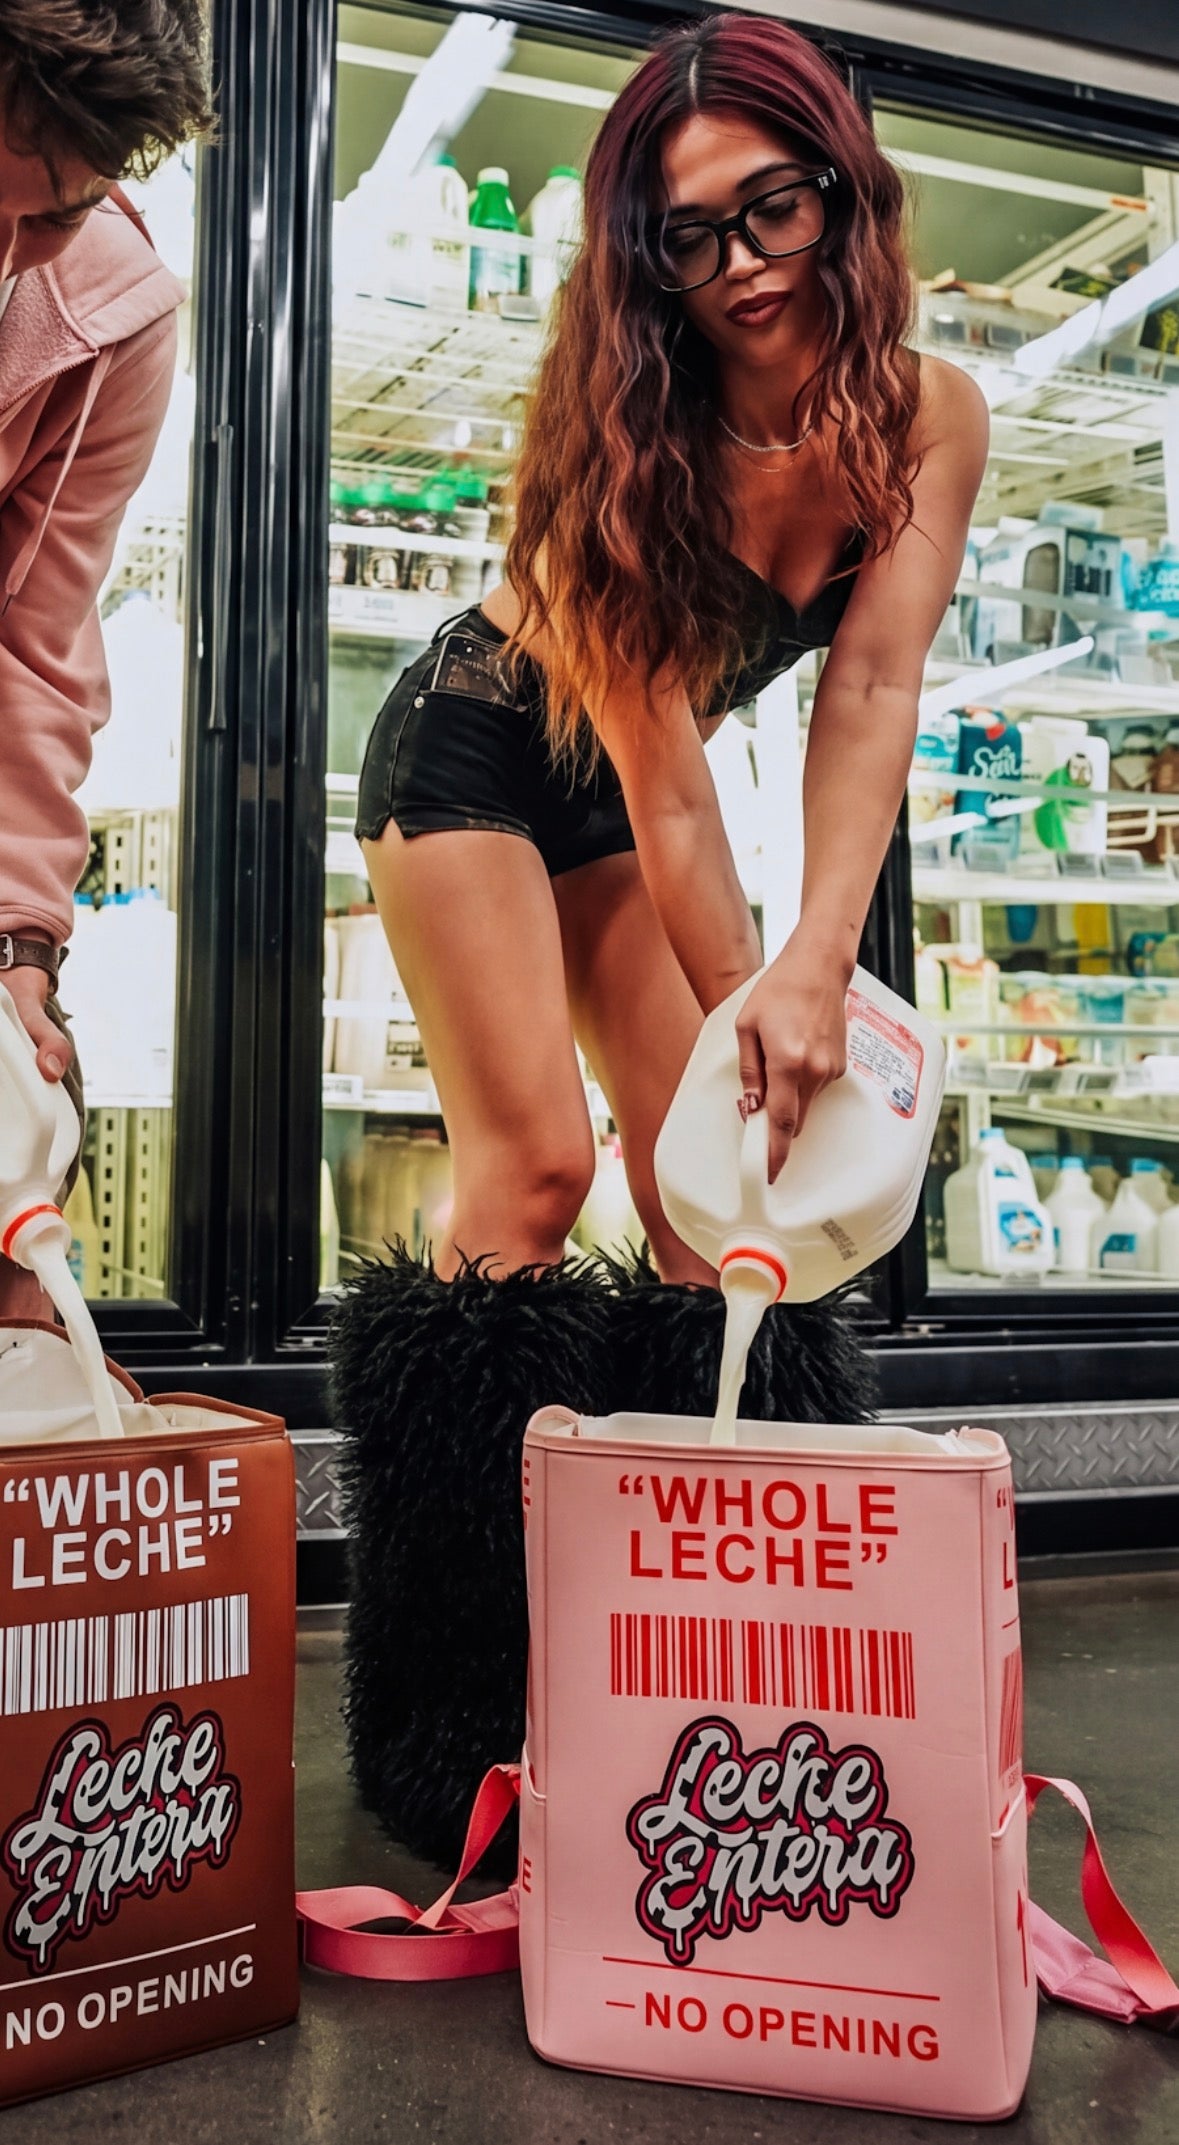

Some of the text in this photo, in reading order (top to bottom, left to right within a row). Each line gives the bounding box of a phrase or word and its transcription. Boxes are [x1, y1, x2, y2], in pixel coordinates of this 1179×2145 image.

[4, 1458, 241, 1529] “WHOLE
[618, 1474, 899, 1536] “WHOLE
[12, 1513, 232, 1590] LECHE”
[630, 1529, 888, 1591] LECHE”
[10, 1713, 217, 1876] Leche
[637, 1727, 877, 1856] Leche
[15, 1785, 233, 1964] Entera
[647, 1818, 902, 1951] Entera
[6, 1954, 253, 2050] NO OPENING
[722, 2002, 940, 2062] OPENING
